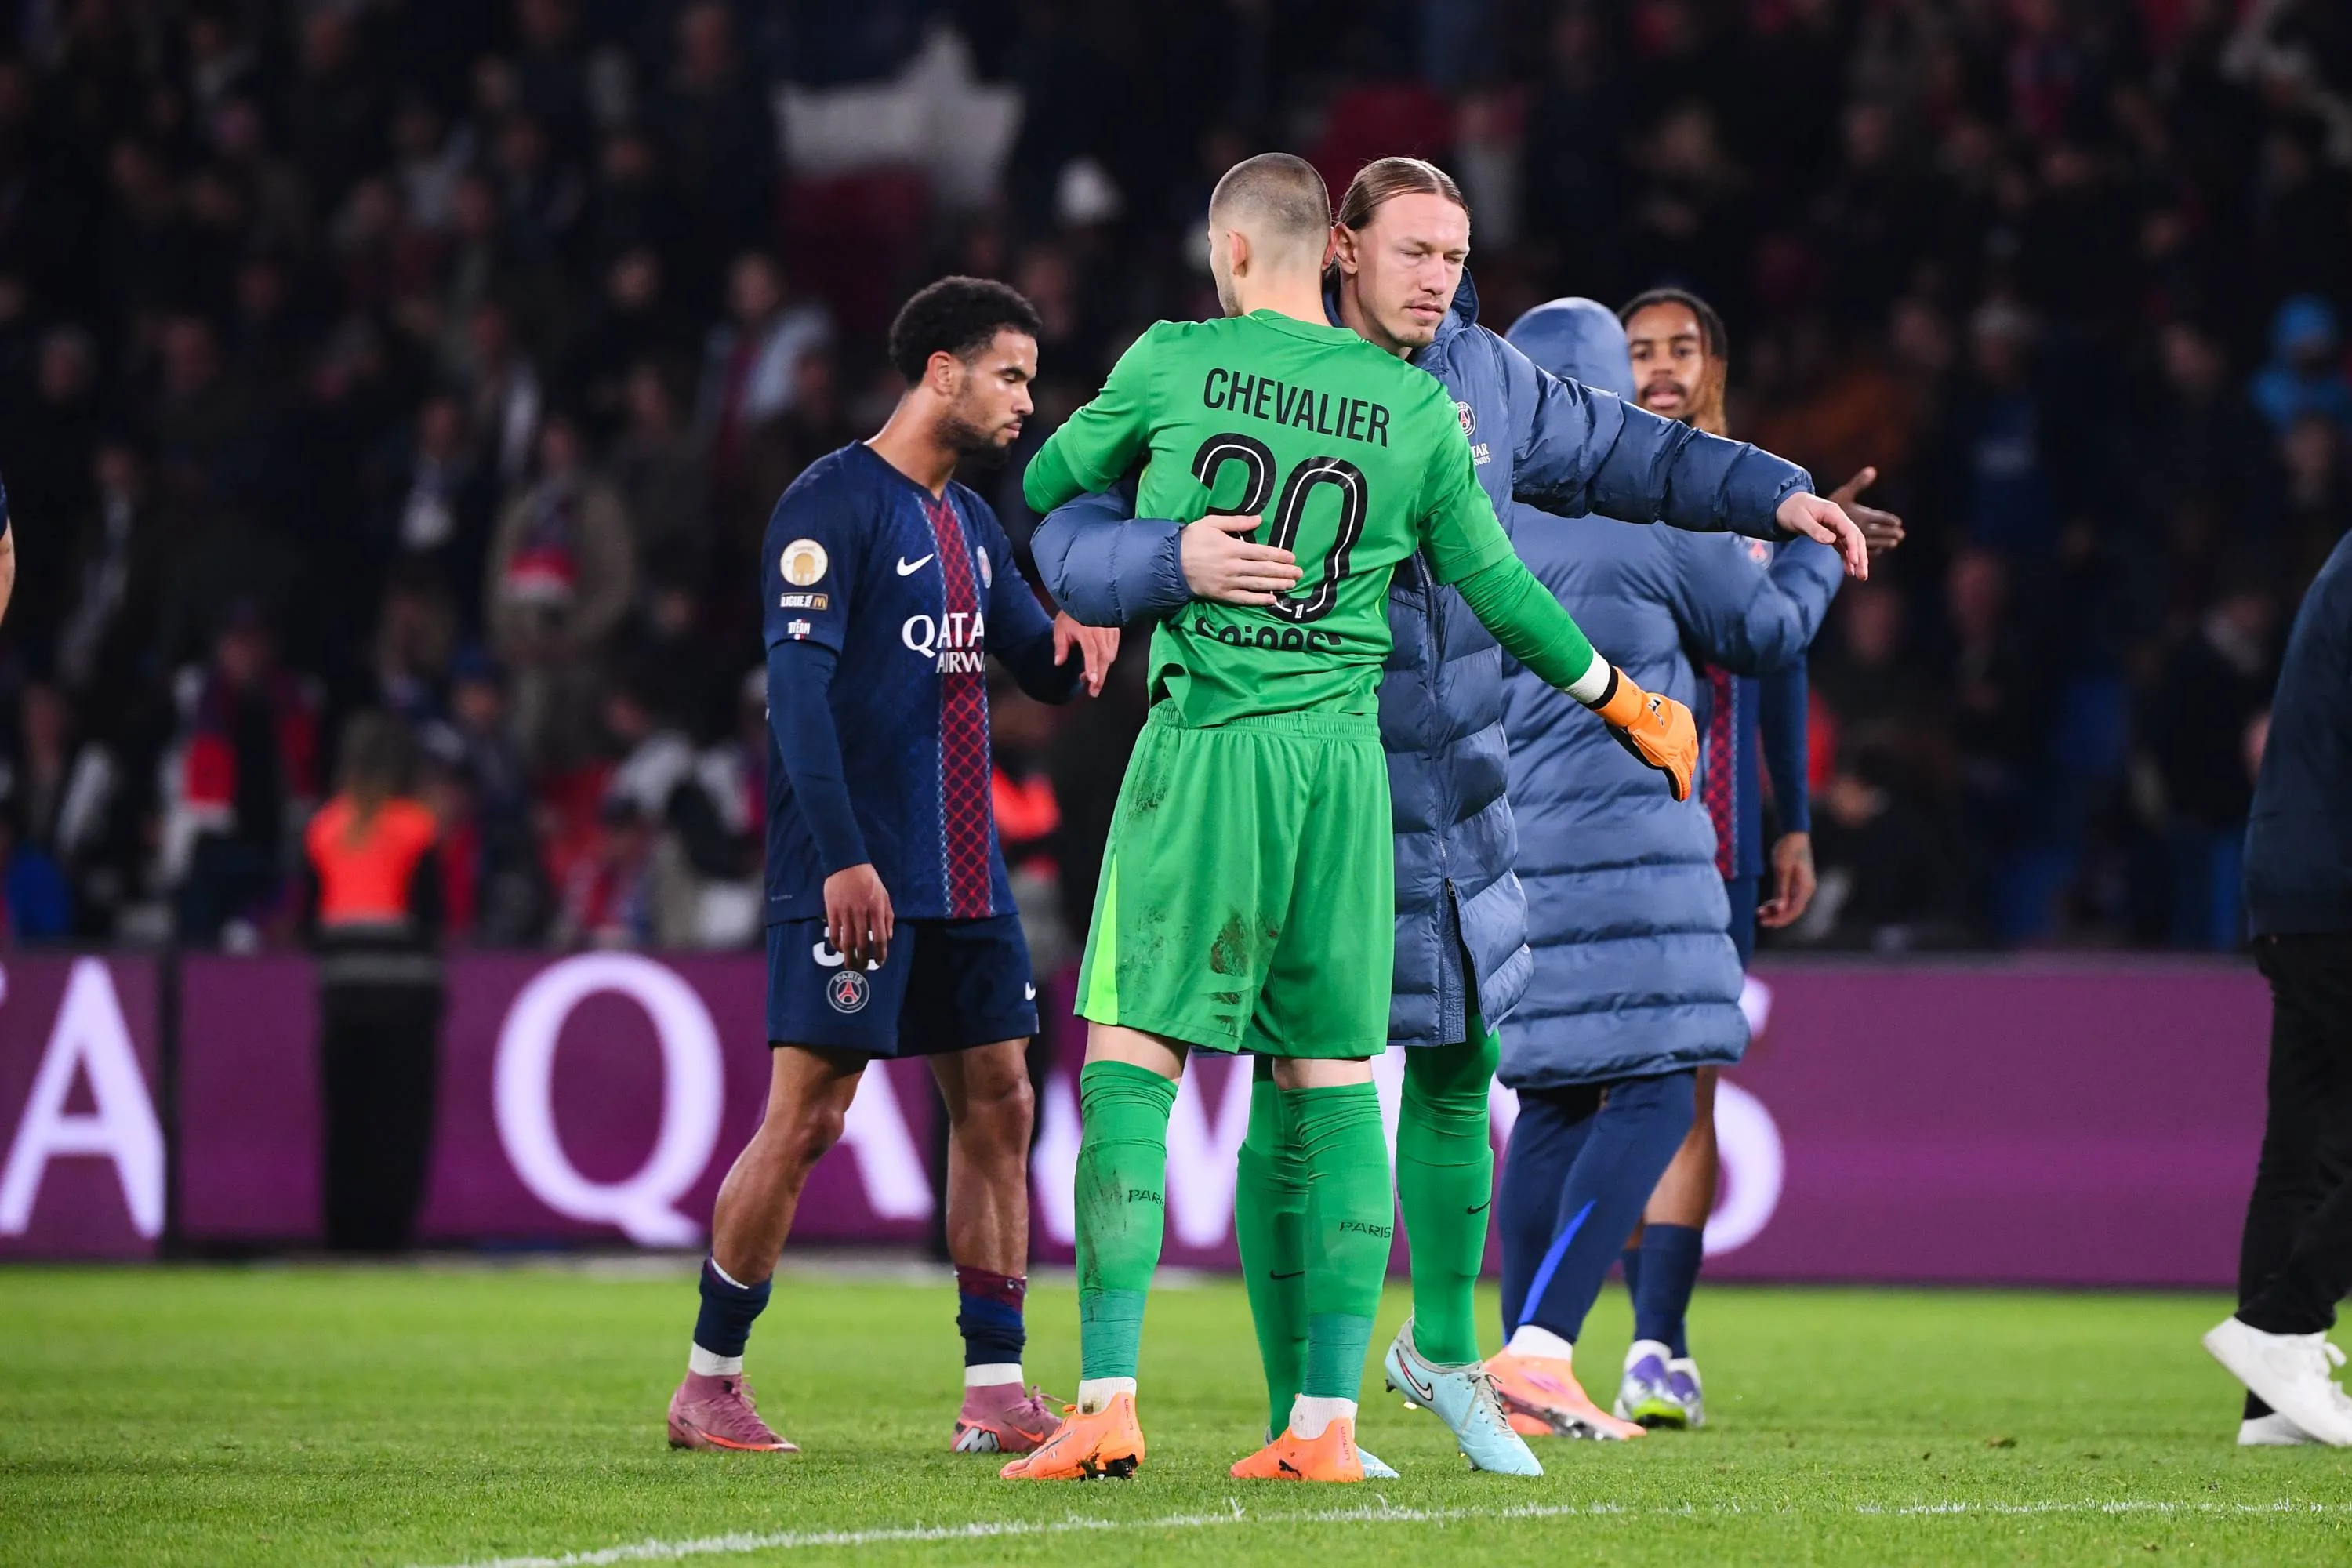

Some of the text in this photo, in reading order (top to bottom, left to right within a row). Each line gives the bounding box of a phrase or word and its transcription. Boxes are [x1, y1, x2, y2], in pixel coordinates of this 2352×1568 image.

[1203, 368, 1390, 447] CHEVALIER
[902, 612, 985, 659] QATA
[935, 651, 986, 673] AIRW
[1339, 1221, 1391, 1239] PARIS
